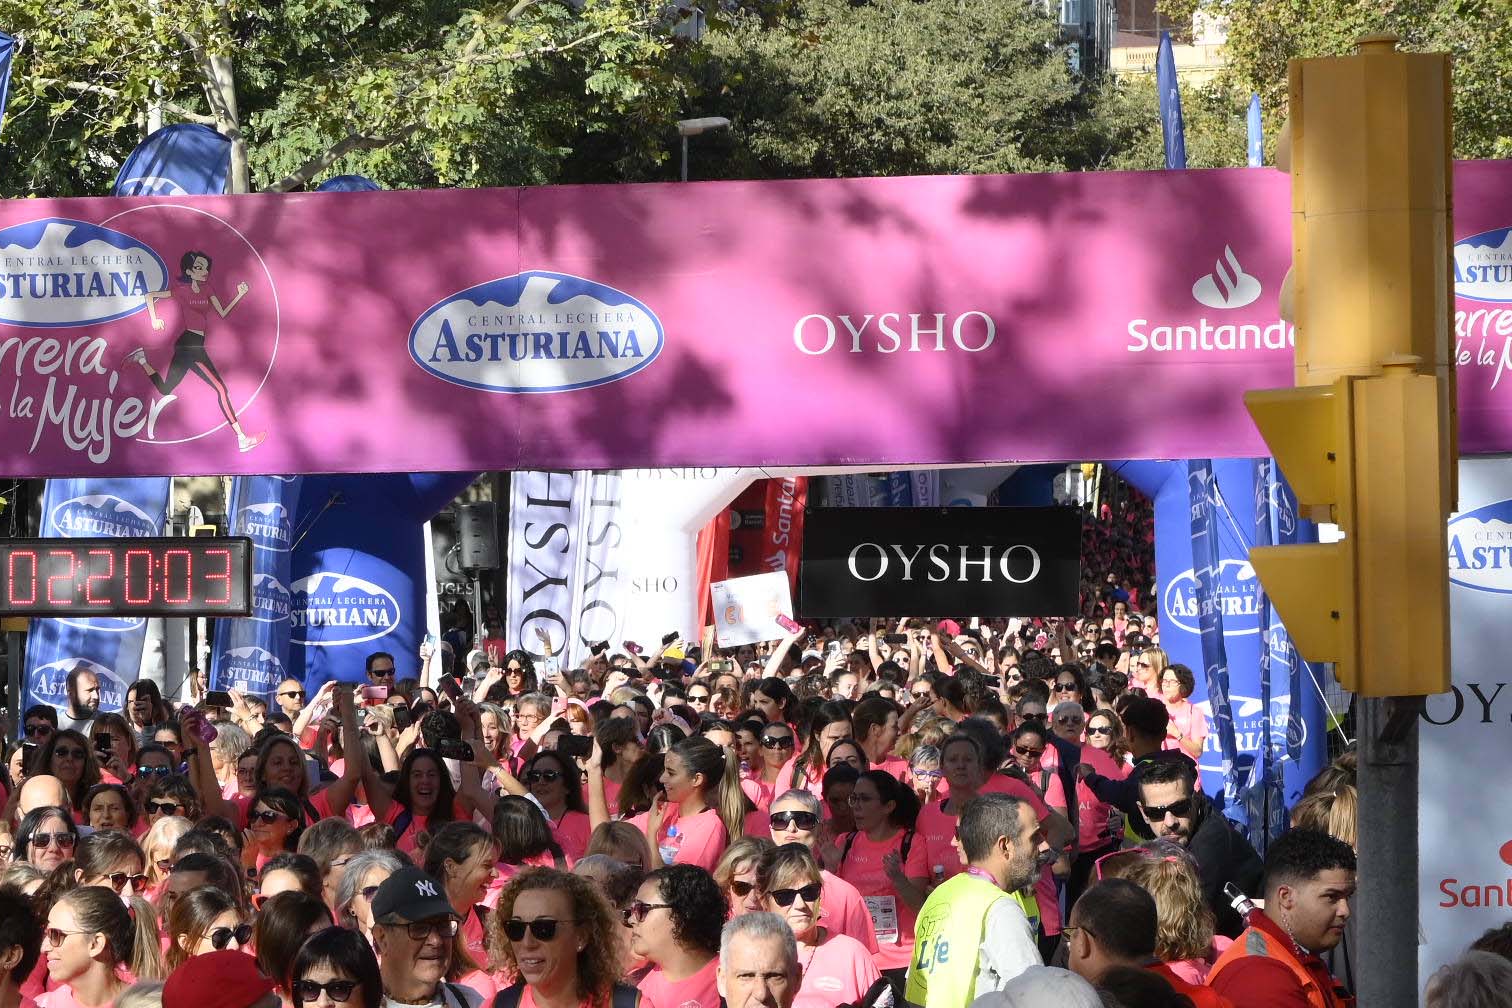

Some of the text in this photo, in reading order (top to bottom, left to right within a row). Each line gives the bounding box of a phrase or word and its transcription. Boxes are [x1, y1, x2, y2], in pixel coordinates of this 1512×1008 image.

[71, 254, 143, 266] LECHERA
[468, 311, 635, 327] CENTRAL LECHERA
[793, 310, 997, 355] OYSHO
[1127, 319, 1295, 352] Santand
[427, 317, 644, 363] ASTURIANA
[9, 377, 34, 418] la
[28, 369, 178, 464] Mujer
[8, 551, 231, 604] 02:20:03
[519, 471, 574, 657] OYSH
[578, 471, 622, 649] OYSH
[848, 543, 1040, 583] OYSHO
[290, 608, 391, 628] STURIANA
[337, 597, 386, 606] LECHERA
[1419, 683, 1512, 725] OY
[916, 934, 949, 974] Lfe
